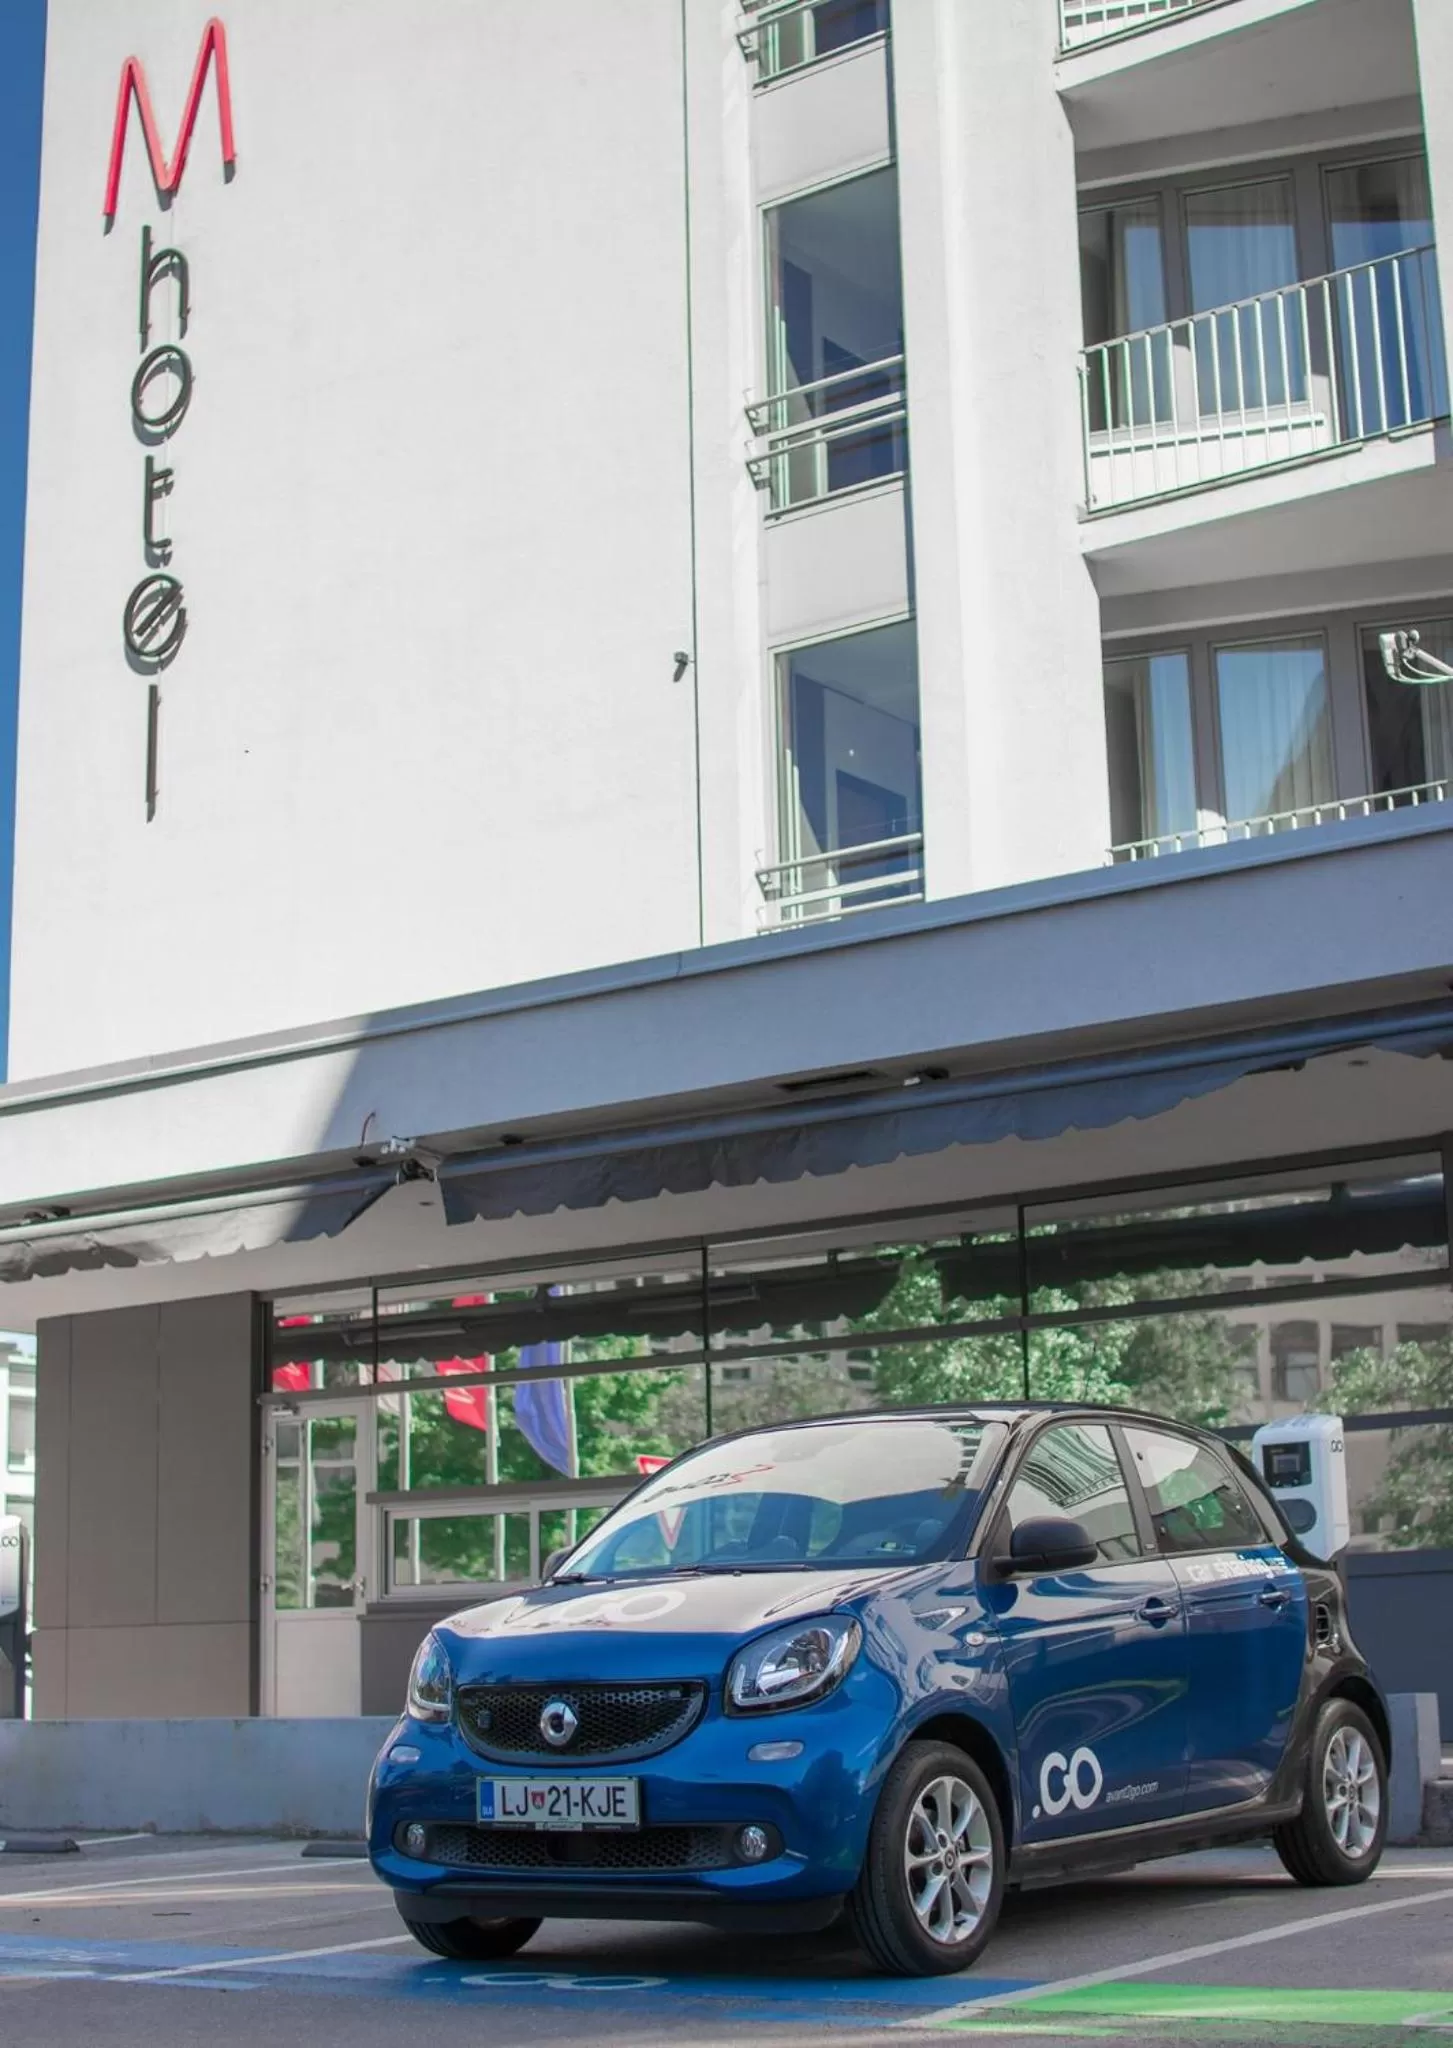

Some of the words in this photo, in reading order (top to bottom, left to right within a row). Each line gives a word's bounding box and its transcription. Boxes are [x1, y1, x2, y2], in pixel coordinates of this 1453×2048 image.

[103, 16, 236, 220] M
[501, 1785, 529, 1817] LJ
[547, 1784, 628, 1818] 21-KJE
